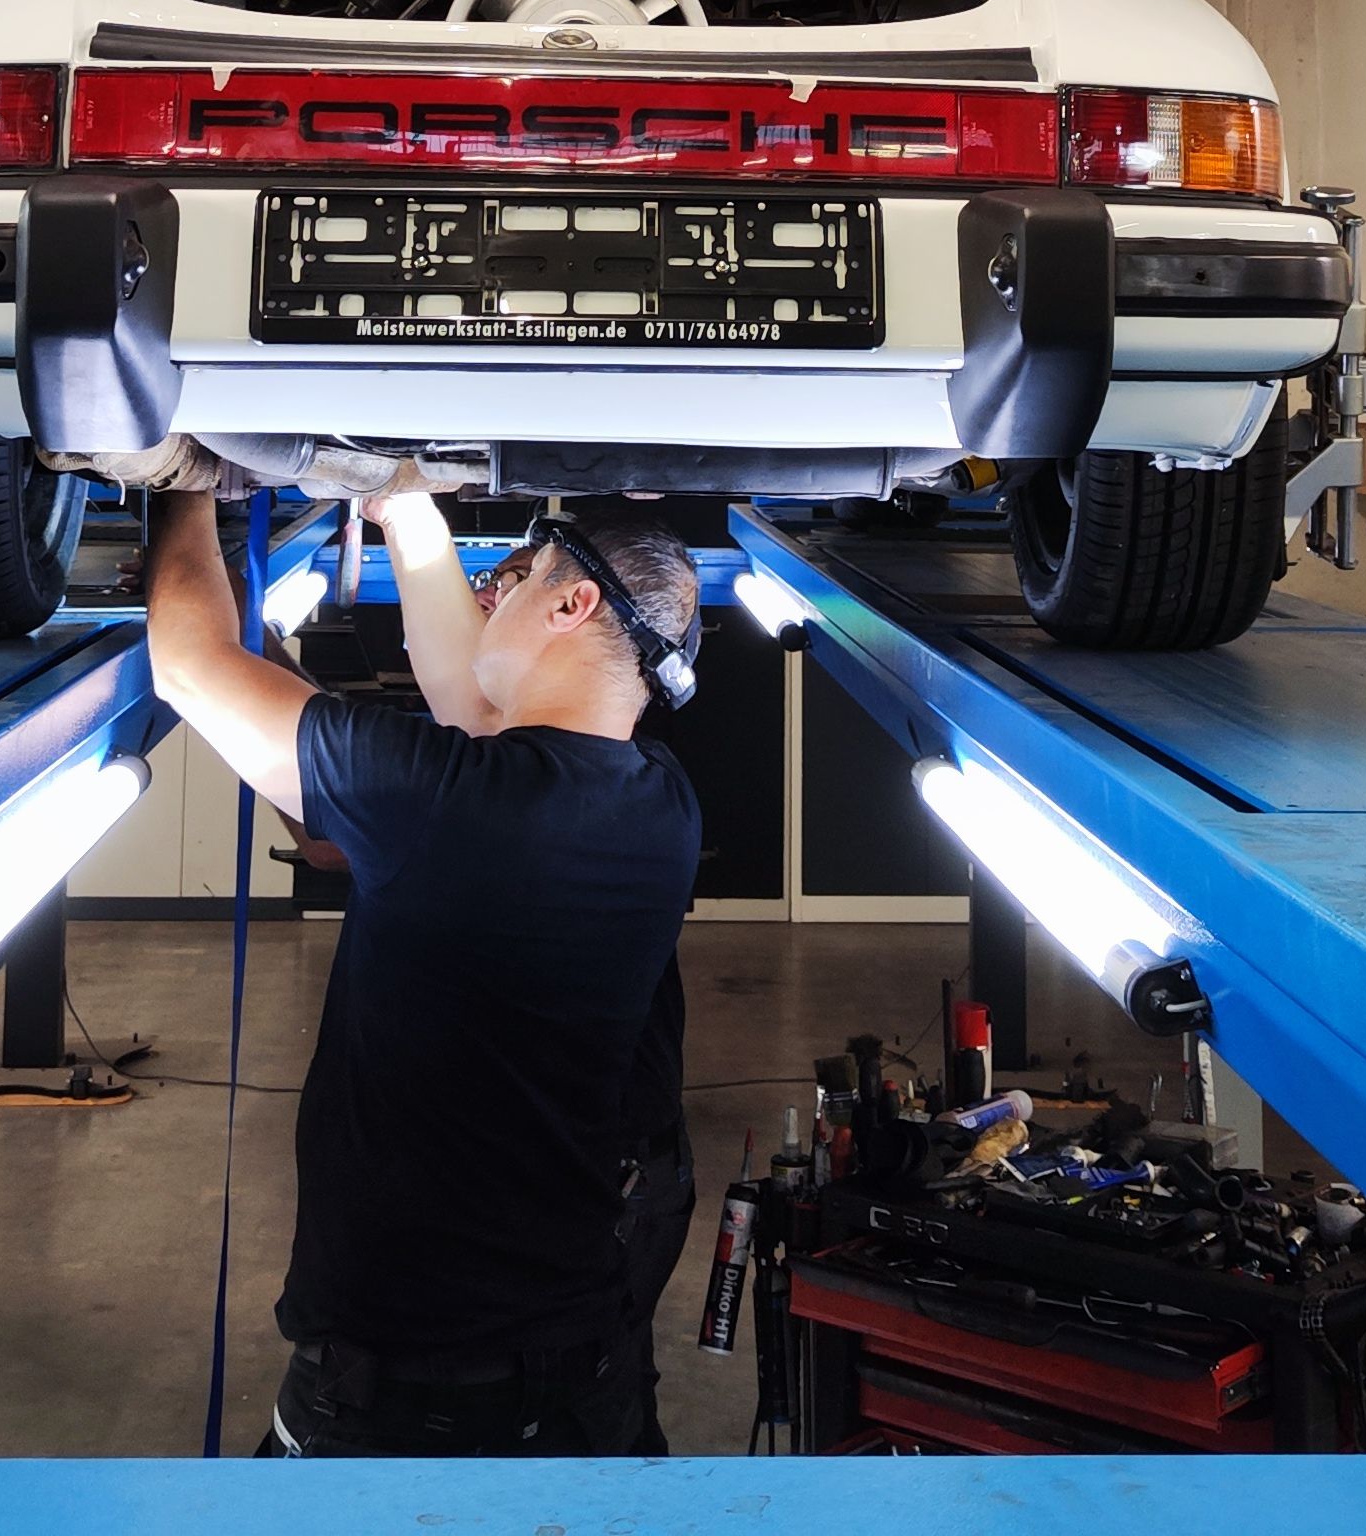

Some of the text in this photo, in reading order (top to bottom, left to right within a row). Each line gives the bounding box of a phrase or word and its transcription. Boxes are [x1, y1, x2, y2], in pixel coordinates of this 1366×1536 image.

[187, 97, 947, 158] PORSCHE
[356, 319, 781, 342] Meisterwerkstatt-Esslingen.de 0711/76164978
[719, 1267, 740, 1313] Dirko
[713, 1317, 731, 1343] HT
